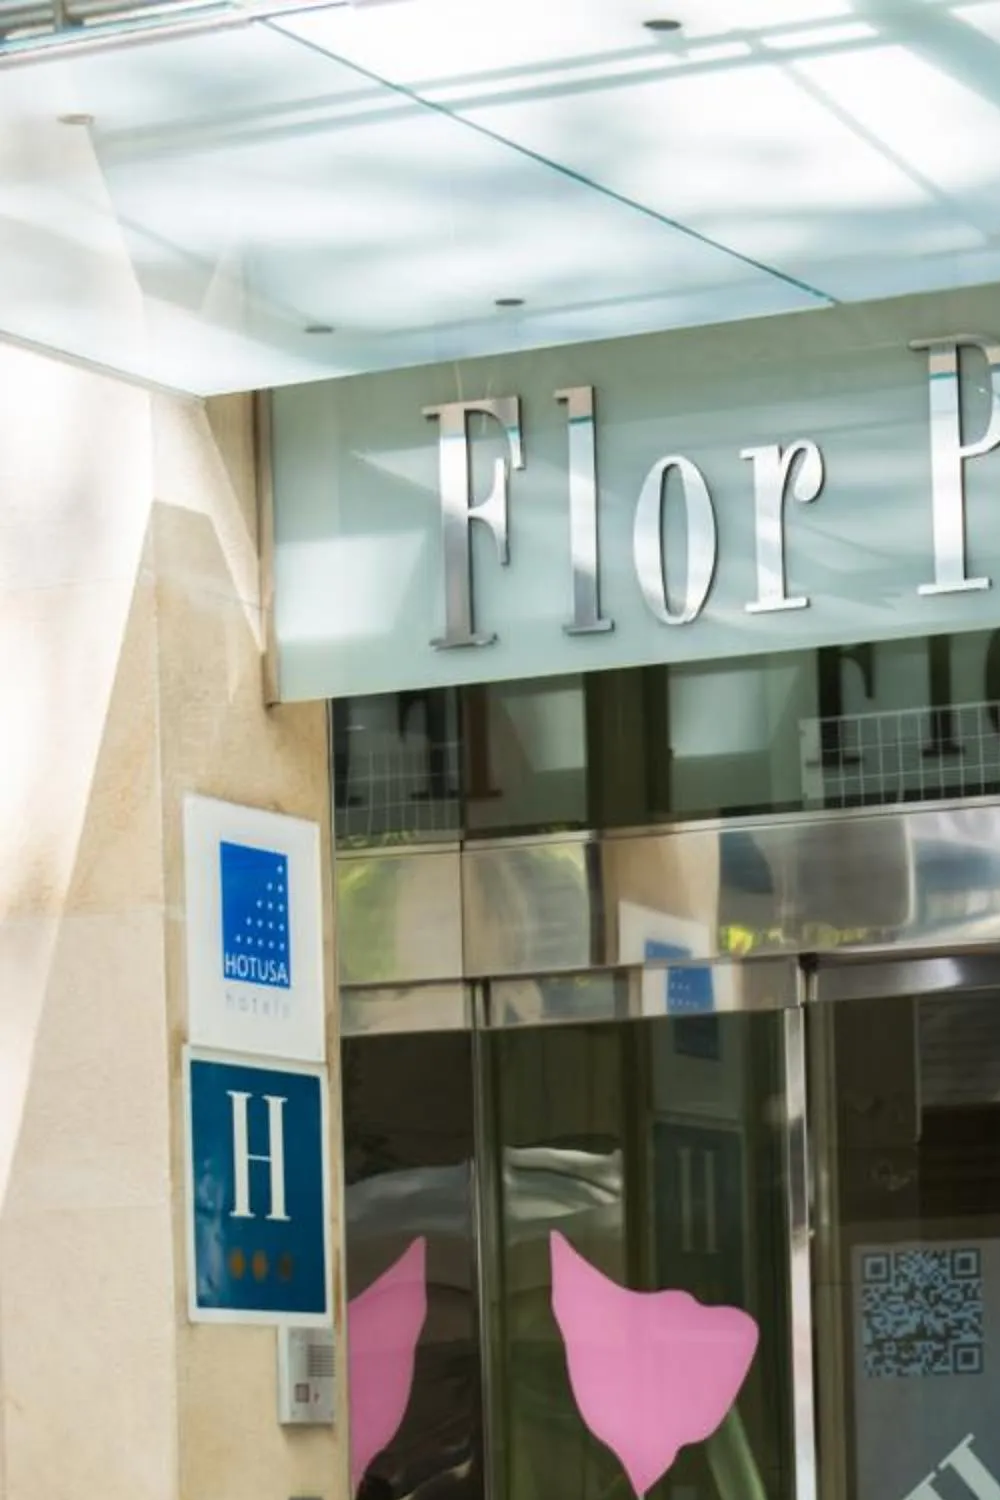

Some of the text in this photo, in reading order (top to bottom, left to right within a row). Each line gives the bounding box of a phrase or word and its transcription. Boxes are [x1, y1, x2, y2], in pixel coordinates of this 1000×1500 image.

[422, 385, 826, 651] Flor
[224, 952, 289, 985] HOTUSA
[226, 1090, 291, 1221] H
